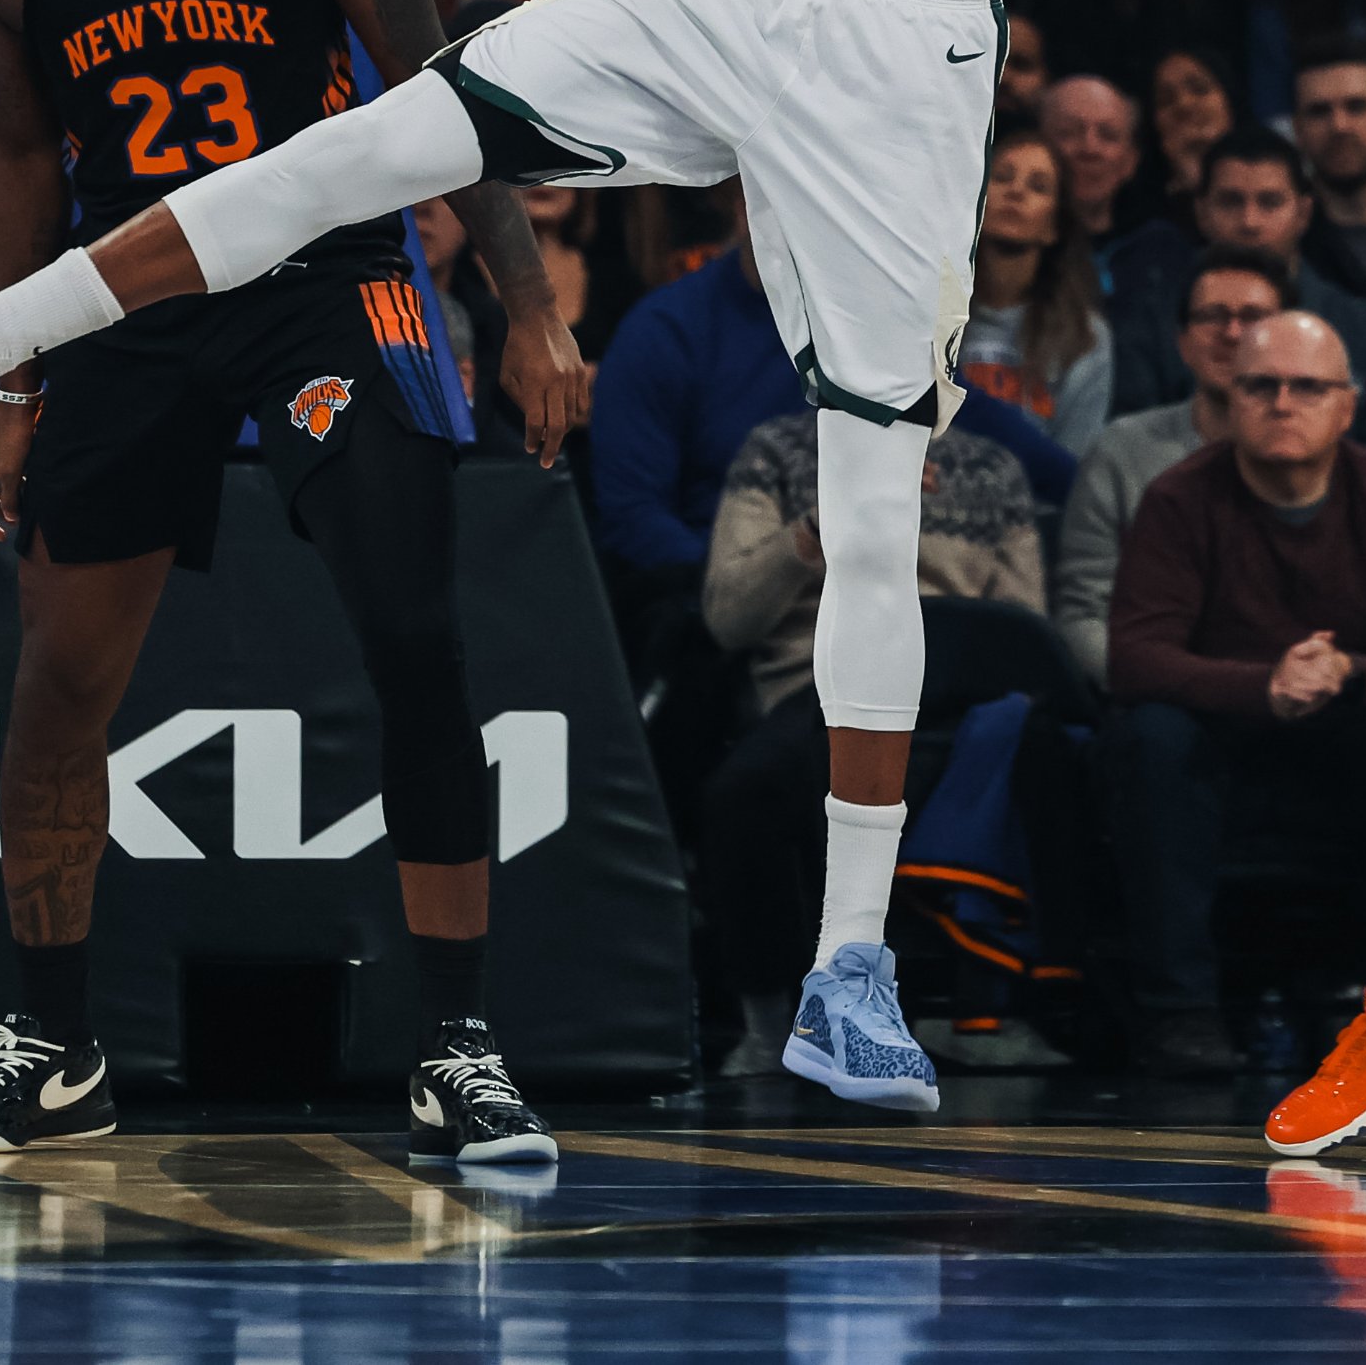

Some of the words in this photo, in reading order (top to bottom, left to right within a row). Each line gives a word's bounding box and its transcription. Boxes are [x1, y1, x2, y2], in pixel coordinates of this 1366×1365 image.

[61, 4, 145, 79] NEW
[106, 62, 263, 178] 23
[295, 379, 348, 422] KNICKS
